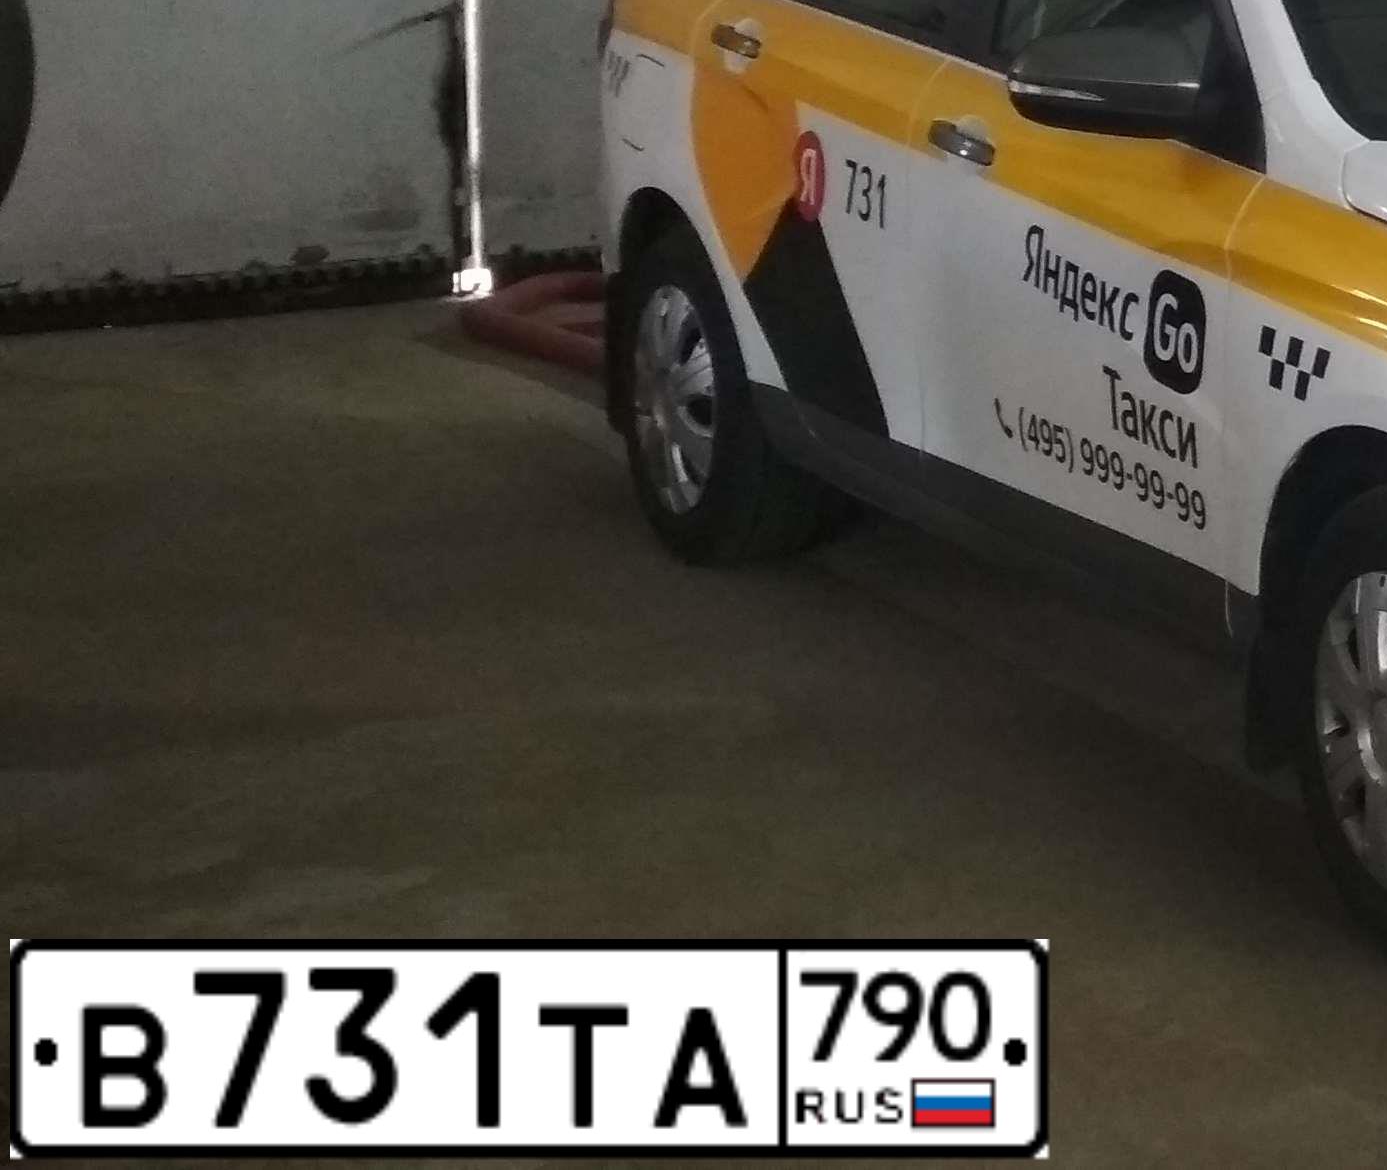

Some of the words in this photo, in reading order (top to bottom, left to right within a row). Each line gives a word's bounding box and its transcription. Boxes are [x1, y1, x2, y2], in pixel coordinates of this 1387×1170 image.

[800, 148, 817, 206] Я
[845, 158, 886, 229] 731
[1022, 224, 1139, 341] Яндекс
[1153, 293, 1199, 373] Go
[1018, 407, 1074, 473] (495)
[1080, 438, 1206, 530] 999-99-99
[1102, 365, 1198, 469] Такси
